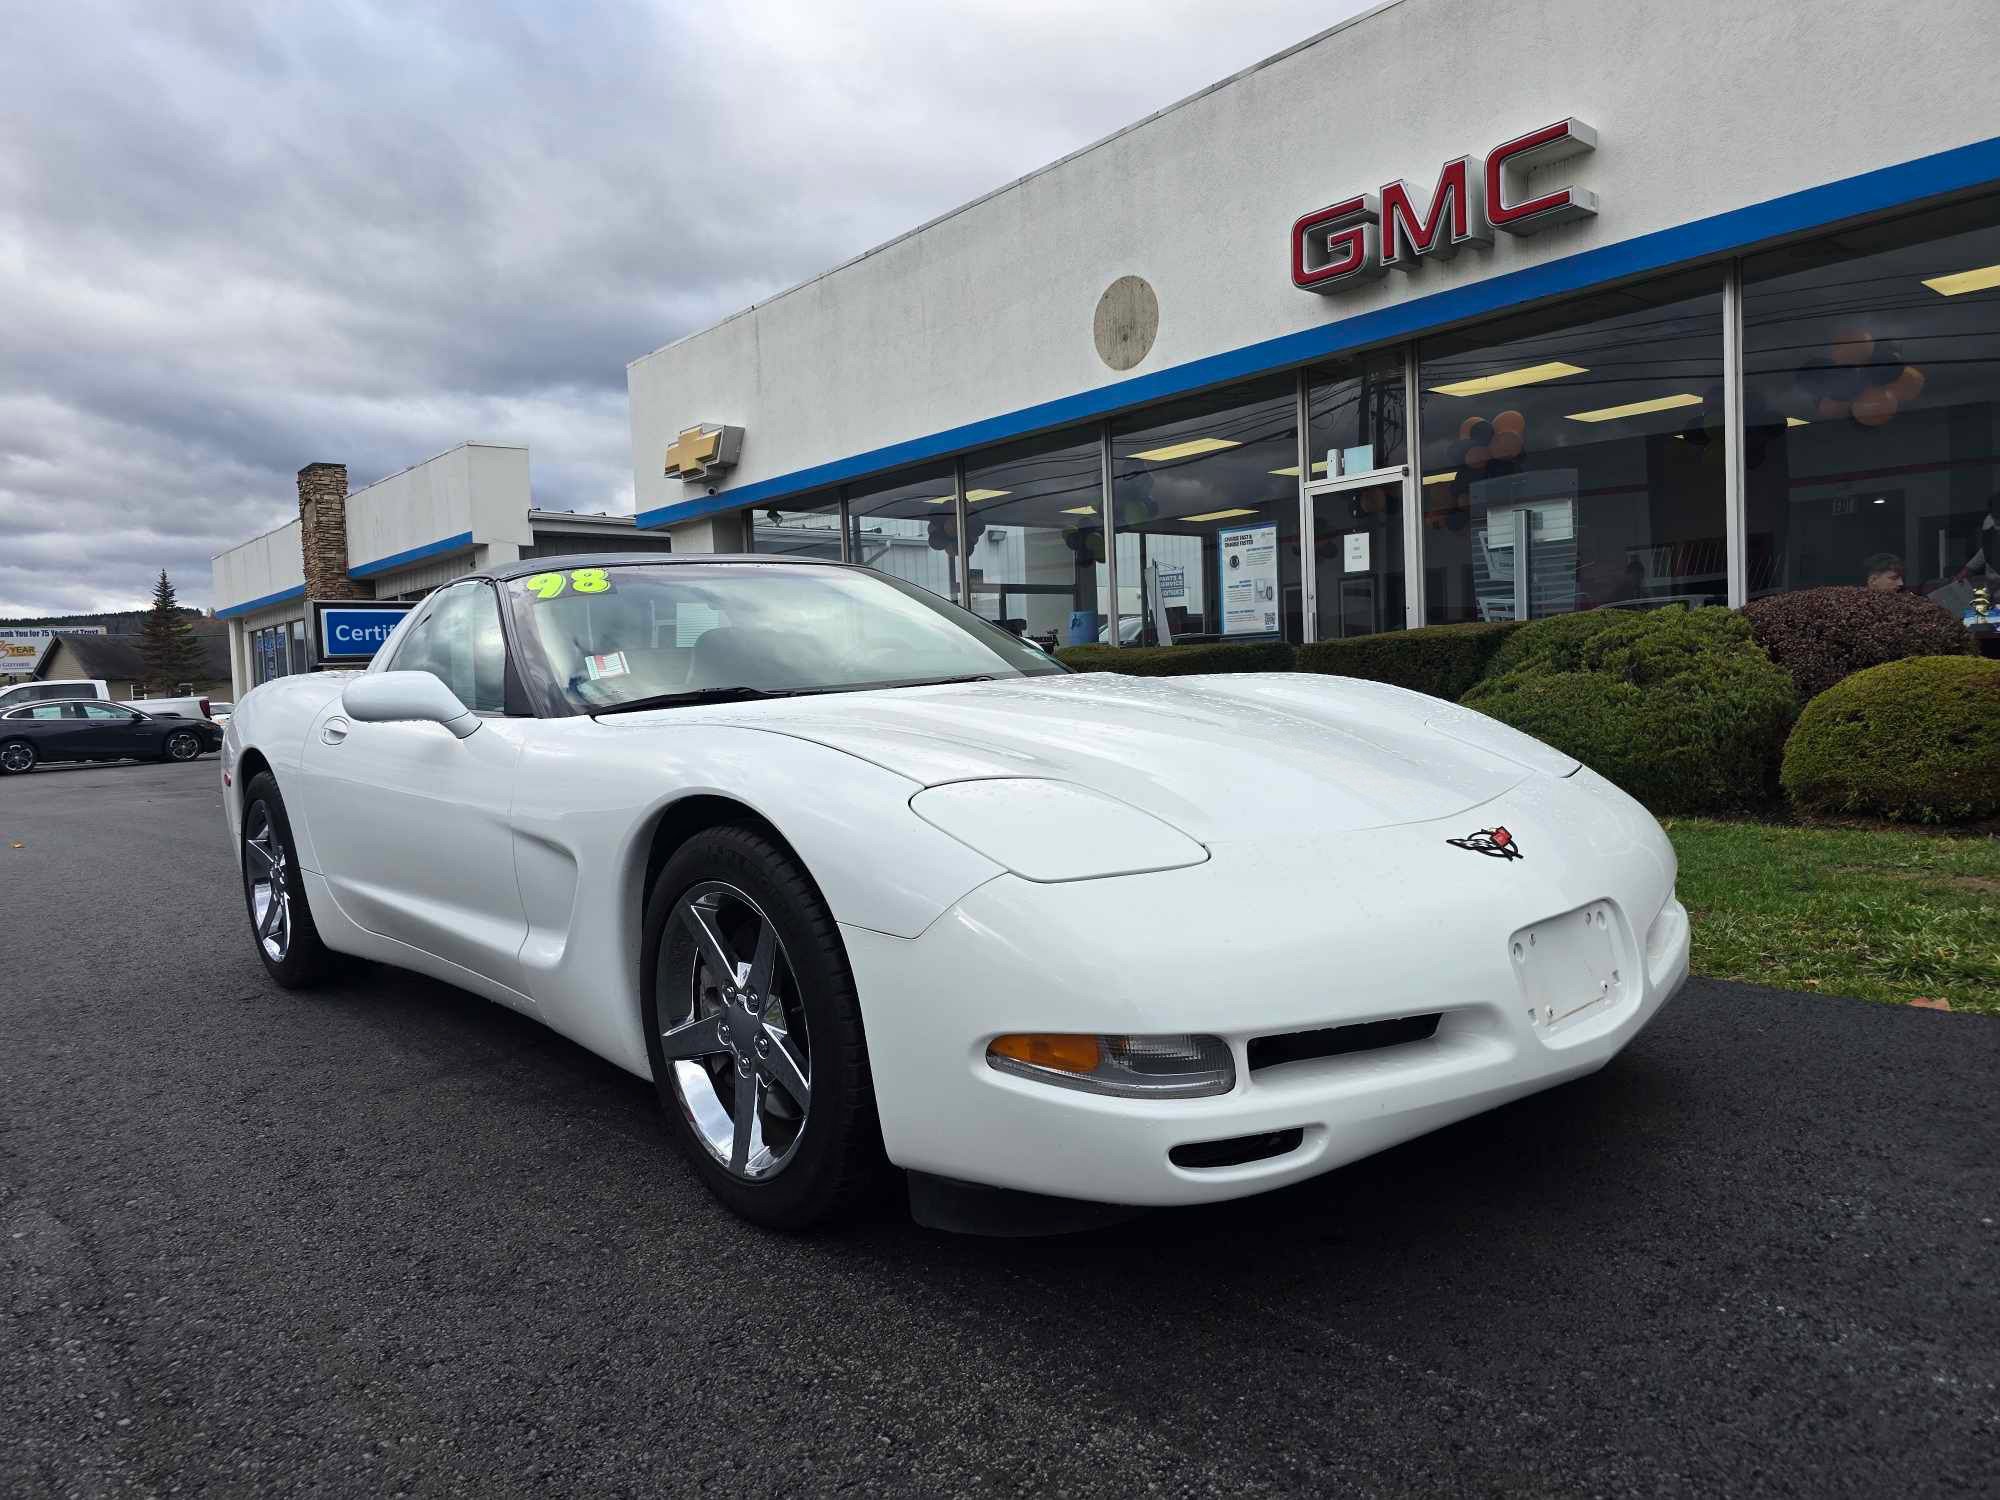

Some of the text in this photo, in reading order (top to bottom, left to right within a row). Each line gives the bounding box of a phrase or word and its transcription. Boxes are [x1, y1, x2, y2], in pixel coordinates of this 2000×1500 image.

[1291, 117, 1600, 296] GMC
[526, 568, 610, 599] 98
[29, 629, 40, 637] for
[41, 629, 50, 637] 75
